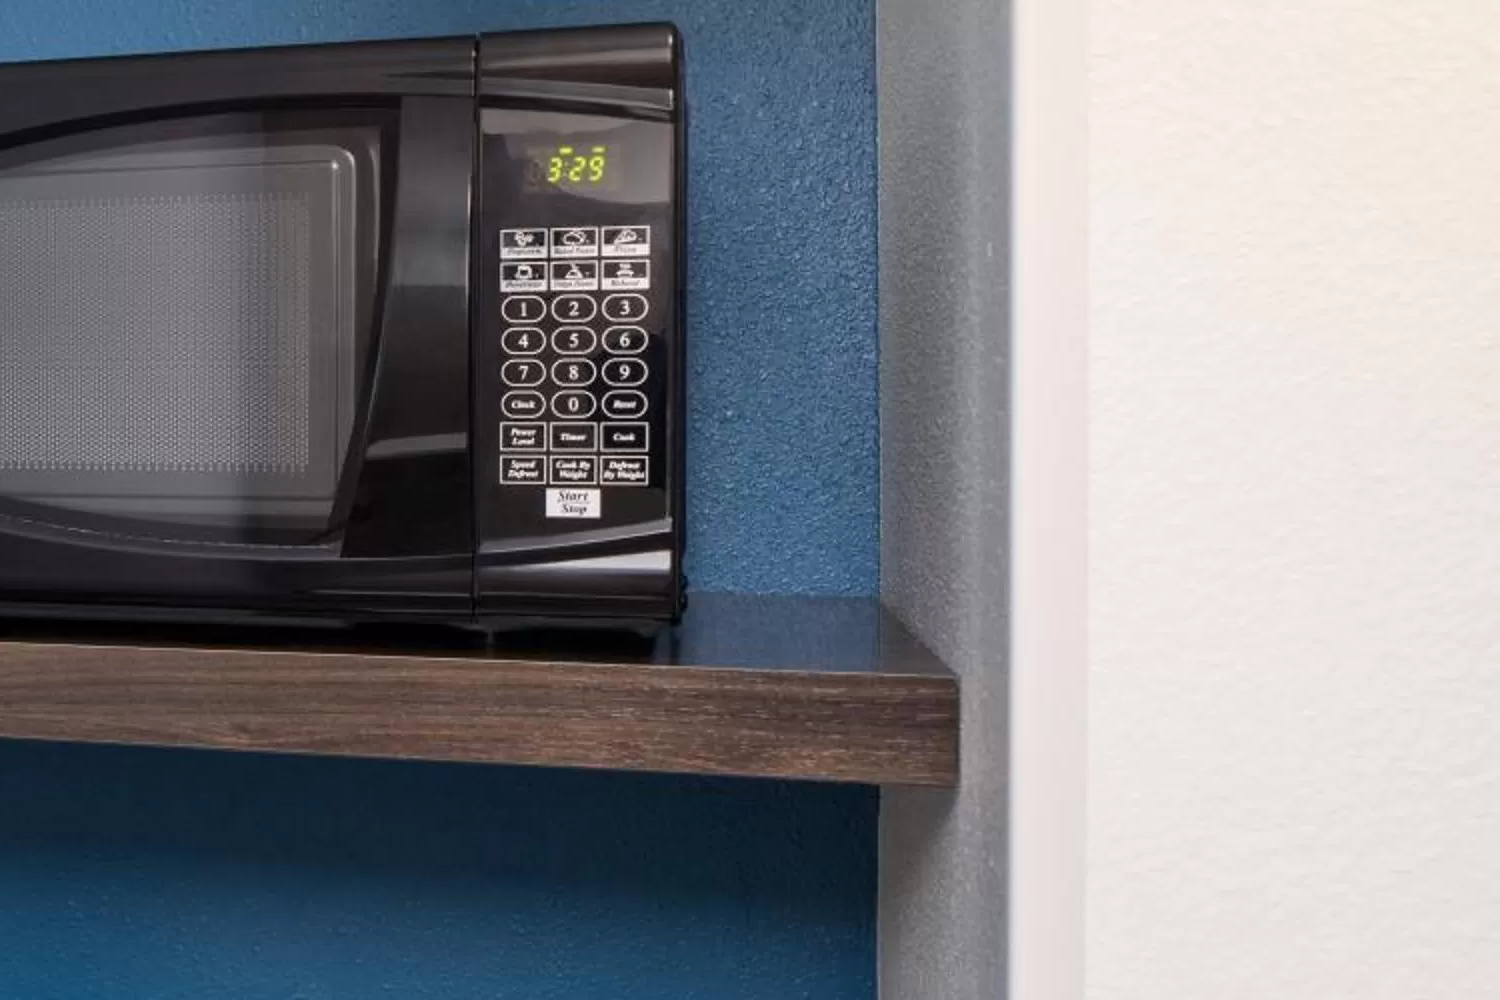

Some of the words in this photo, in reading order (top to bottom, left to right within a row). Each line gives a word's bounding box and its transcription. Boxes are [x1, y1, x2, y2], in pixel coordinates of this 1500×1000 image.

[520, 301, 527, 317] 1
[568, 301, 580, 317] 2
[619, 300, 631, 316] 3
[517, 333, 529, 349] 4
[569, 332, 580, 348] 5
[619, 332, 630, 348] 6
[518, 364, 529, 380] 7
[568, 364, 579, 380] 8
[619, 364, 630, 380] 9
[568, 396, 579, 412] 0
[560, 432, 588, 441] Timer
[612, 432, 636, 441] Cook
[557, 491, 589, 502] Start
[562, 503, 588, 515] Stop
